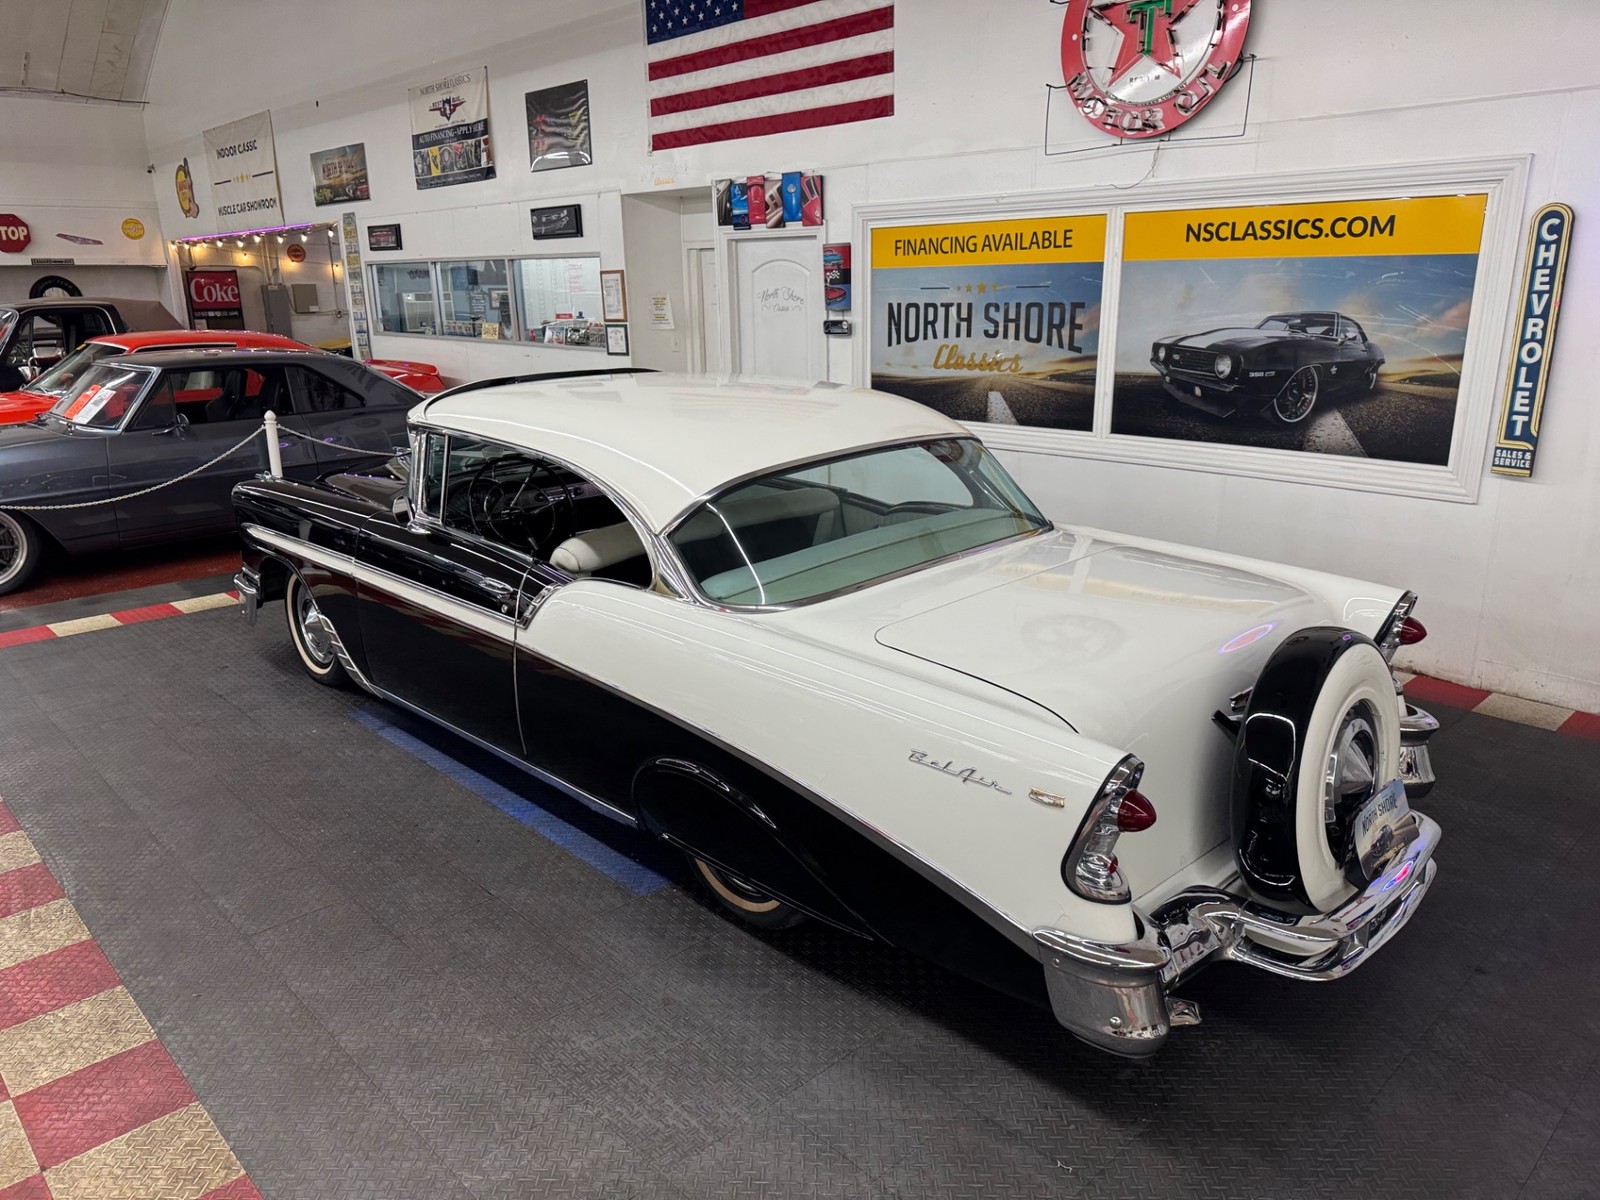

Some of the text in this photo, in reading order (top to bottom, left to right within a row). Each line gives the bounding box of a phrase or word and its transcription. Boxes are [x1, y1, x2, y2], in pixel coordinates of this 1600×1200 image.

[216, 145, 237, 159] INDOOR
[217, 197, 277, 217] MUSCLE CAR SHOWROOM
[0, 226, 28, 241] TOP
[1185, 214, 1396, 243] NSCLASSICS.COM
[894, 229, 1073, 257] FINANCING AVAILABLE
[190, 278, 240, 302] Coke
[781, 286, 805, 305] Shore
[887, 301, 1086, 354] NORTH SHORE
[1511, 217, 1562, 436] CHEVROLET
[932, 343, 1023, 373] Classics
[1494, 457, 1530, 468] SERVICE
[1496, 448, 1532, 460] SALES &
[1361, 792, 1398, 837] NORTH SHORE
